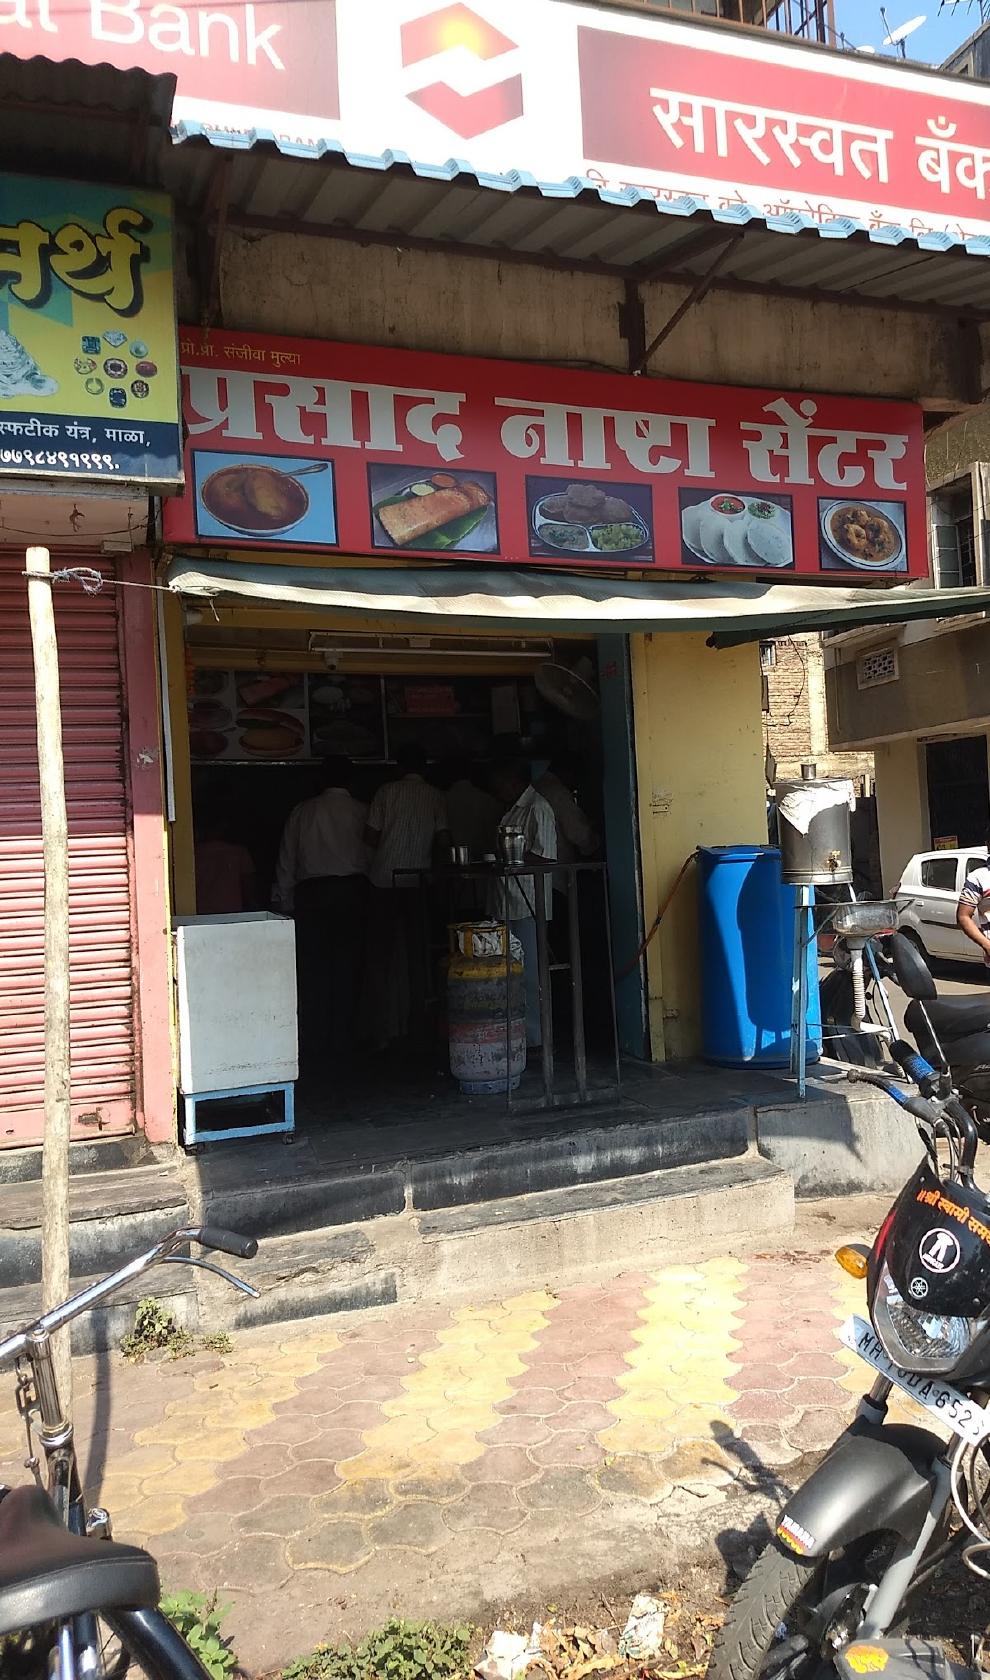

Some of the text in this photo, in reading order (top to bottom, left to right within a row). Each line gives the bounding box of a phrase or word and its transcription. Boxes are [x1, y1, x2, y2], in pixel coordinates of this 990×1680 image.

[90, 0, 286, 71] Bank
[649, 87, 894, 184] सारस्वत
[180, 365, 909, 491] प्रसाद नाष्टा सेंटर
